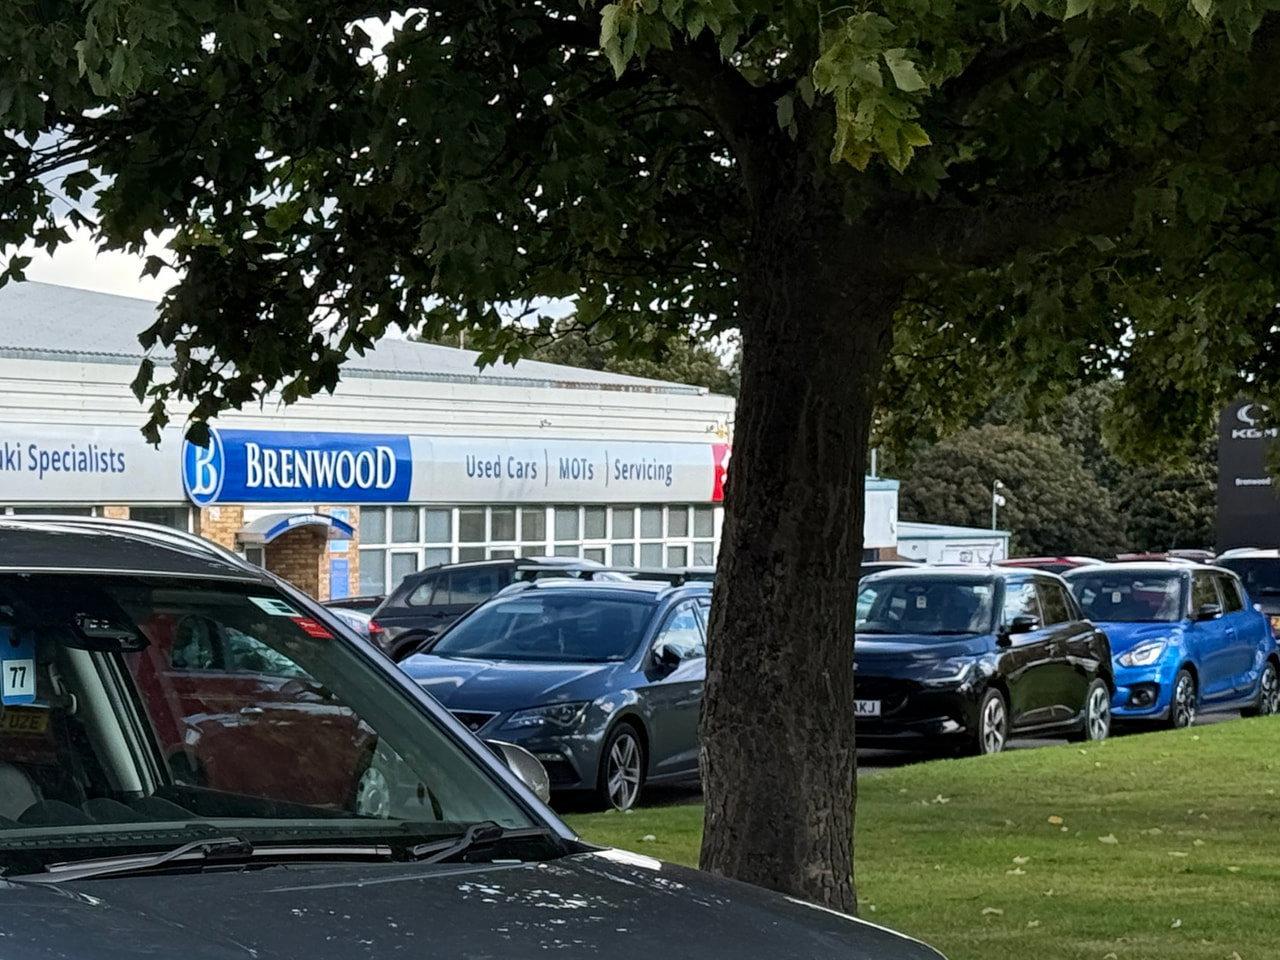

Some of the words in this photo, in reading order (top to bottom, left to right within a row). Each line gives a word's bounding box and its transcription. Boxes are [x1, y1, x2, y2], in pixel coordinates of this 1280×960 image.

[28, 443, 126, 480] Specialists
[245, 442, 397, 489] BRENWOOD
[466, 454, 502, 479] Used
[507, 456, 537, 480] Cars
[559, 457, 594, 480] MOTs
[614, 458, 673, 487] Servicing
[9, 666, 27, 689] 77
